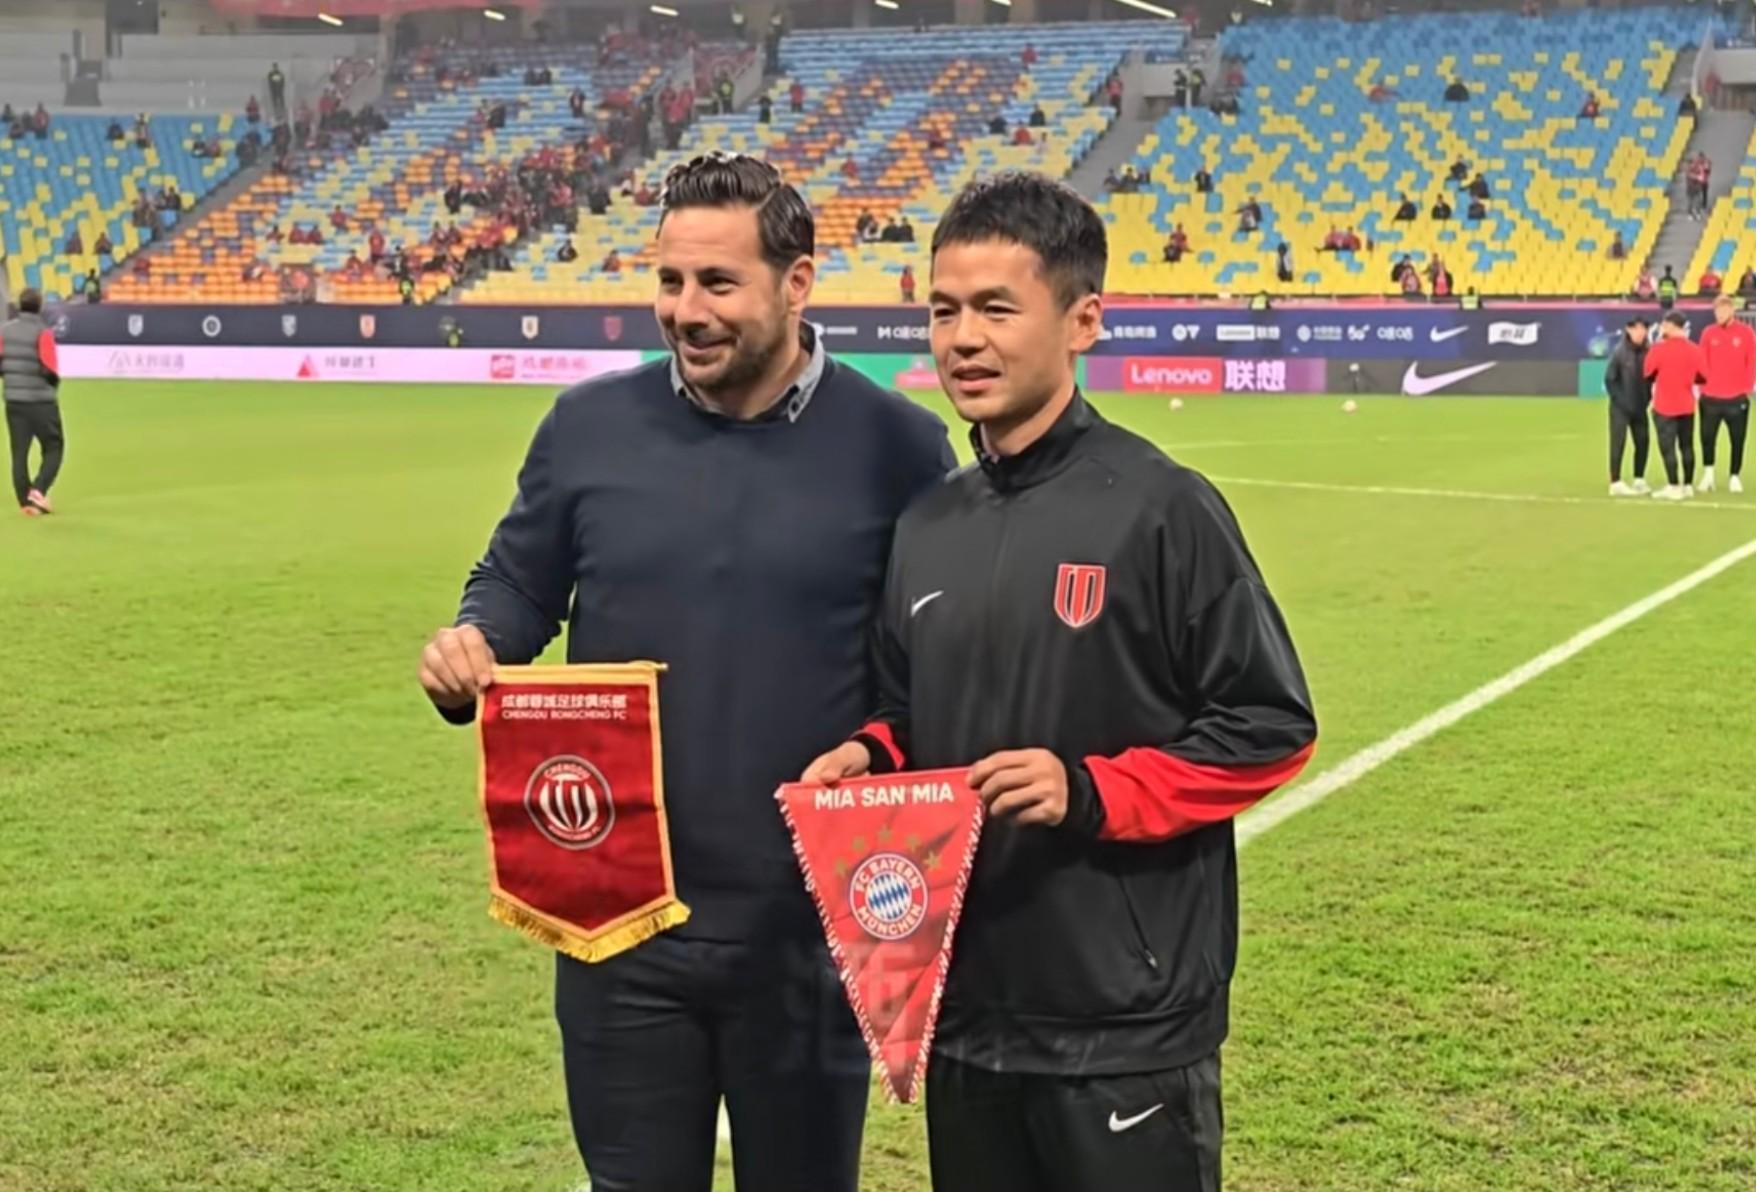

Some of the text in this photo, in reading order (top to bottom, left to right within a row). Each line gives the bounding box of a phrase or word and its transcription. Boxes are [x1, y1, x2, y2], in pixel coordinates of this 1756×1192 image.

[1130, 364, 1213, 385] Lenovo
[1224, 360, 1286, 391] 联想
[613, 710, 626, 720] FC
[815, 782, 955, 811] MIA SAN MIA
[855, 858, 922, 892] FC BAYERN
